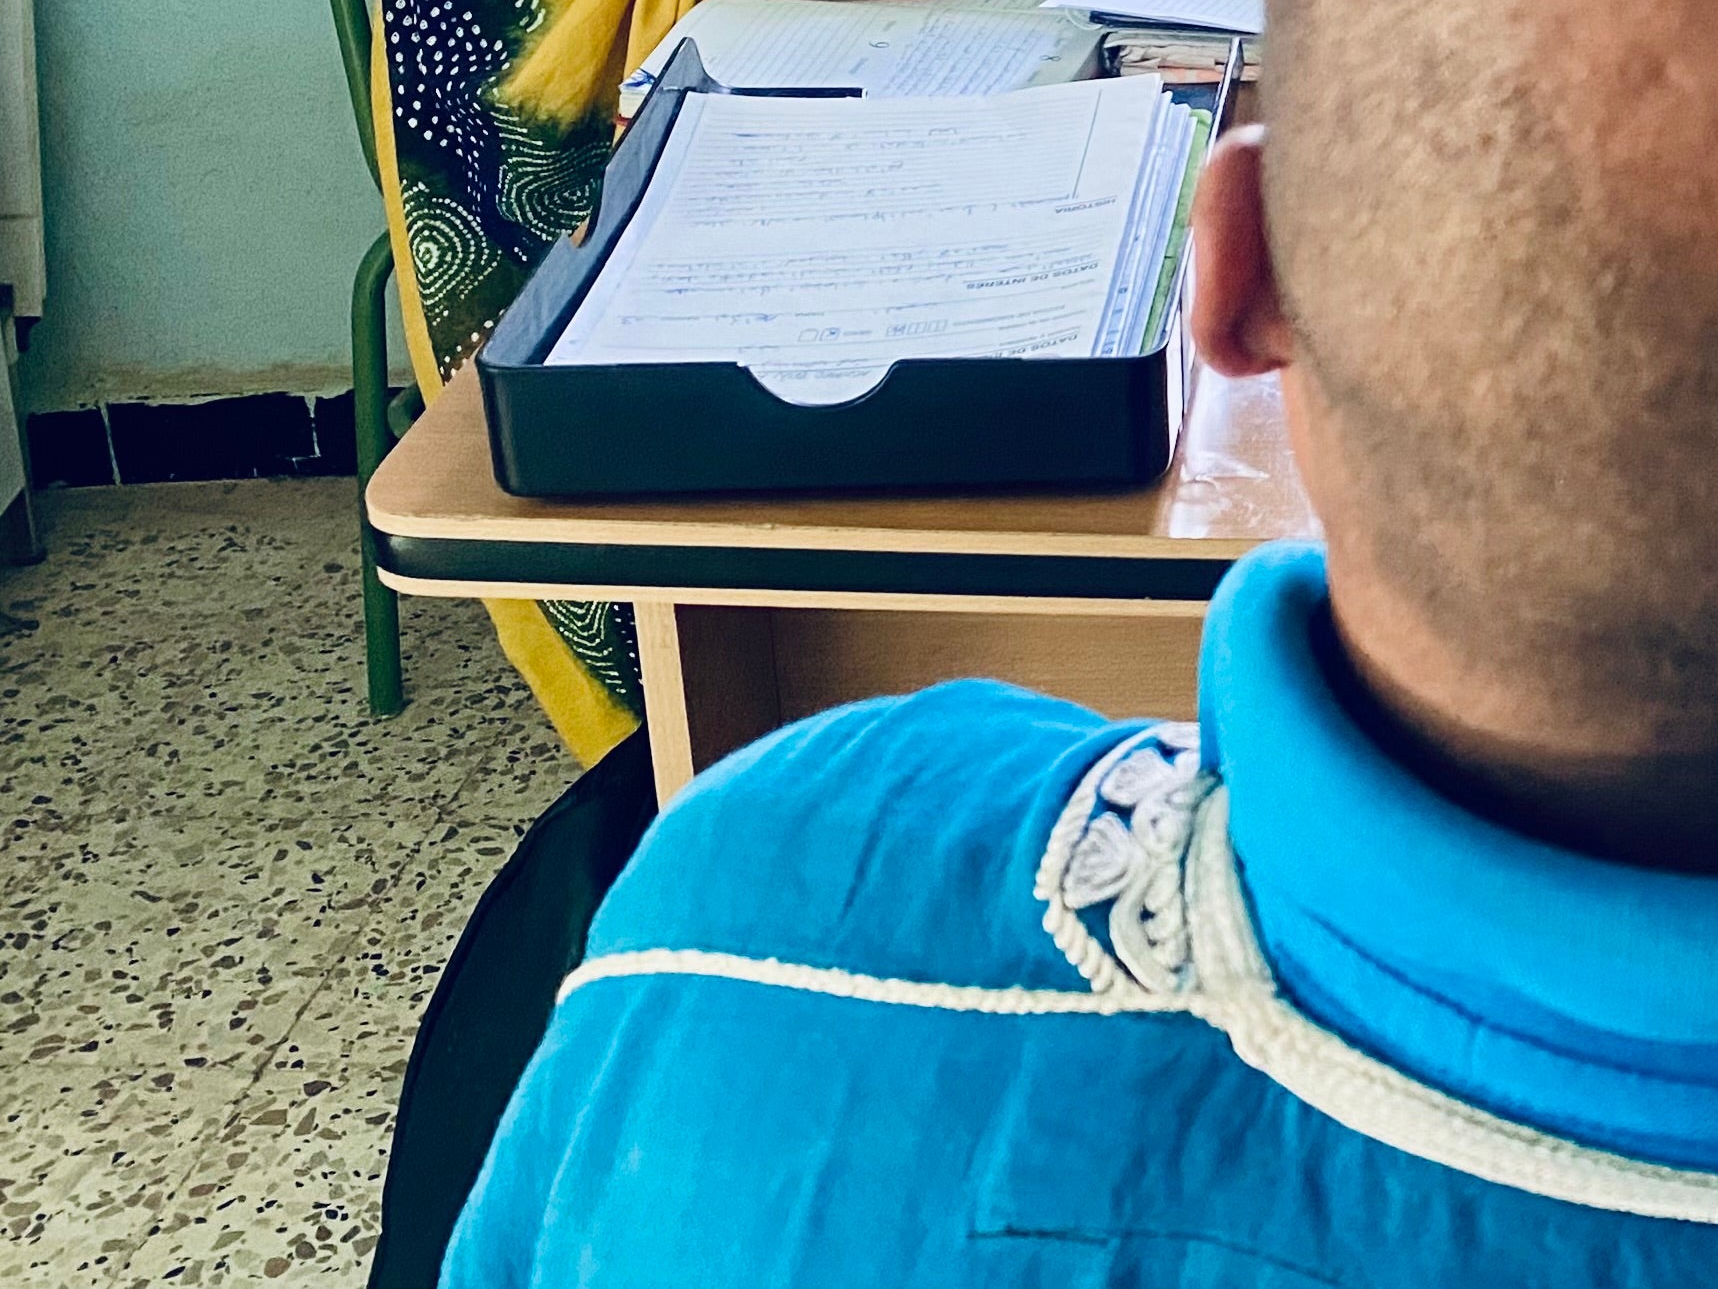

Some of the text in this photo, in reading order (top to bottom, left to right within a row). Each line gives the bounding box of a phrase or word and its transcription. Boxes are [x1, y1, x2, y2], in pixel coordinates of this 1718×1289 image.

[1029, 272, 1050, 283] DE
[1052, 264, 1098, 278] DATOS
[1030, 335, 1078, 352] DATOS
